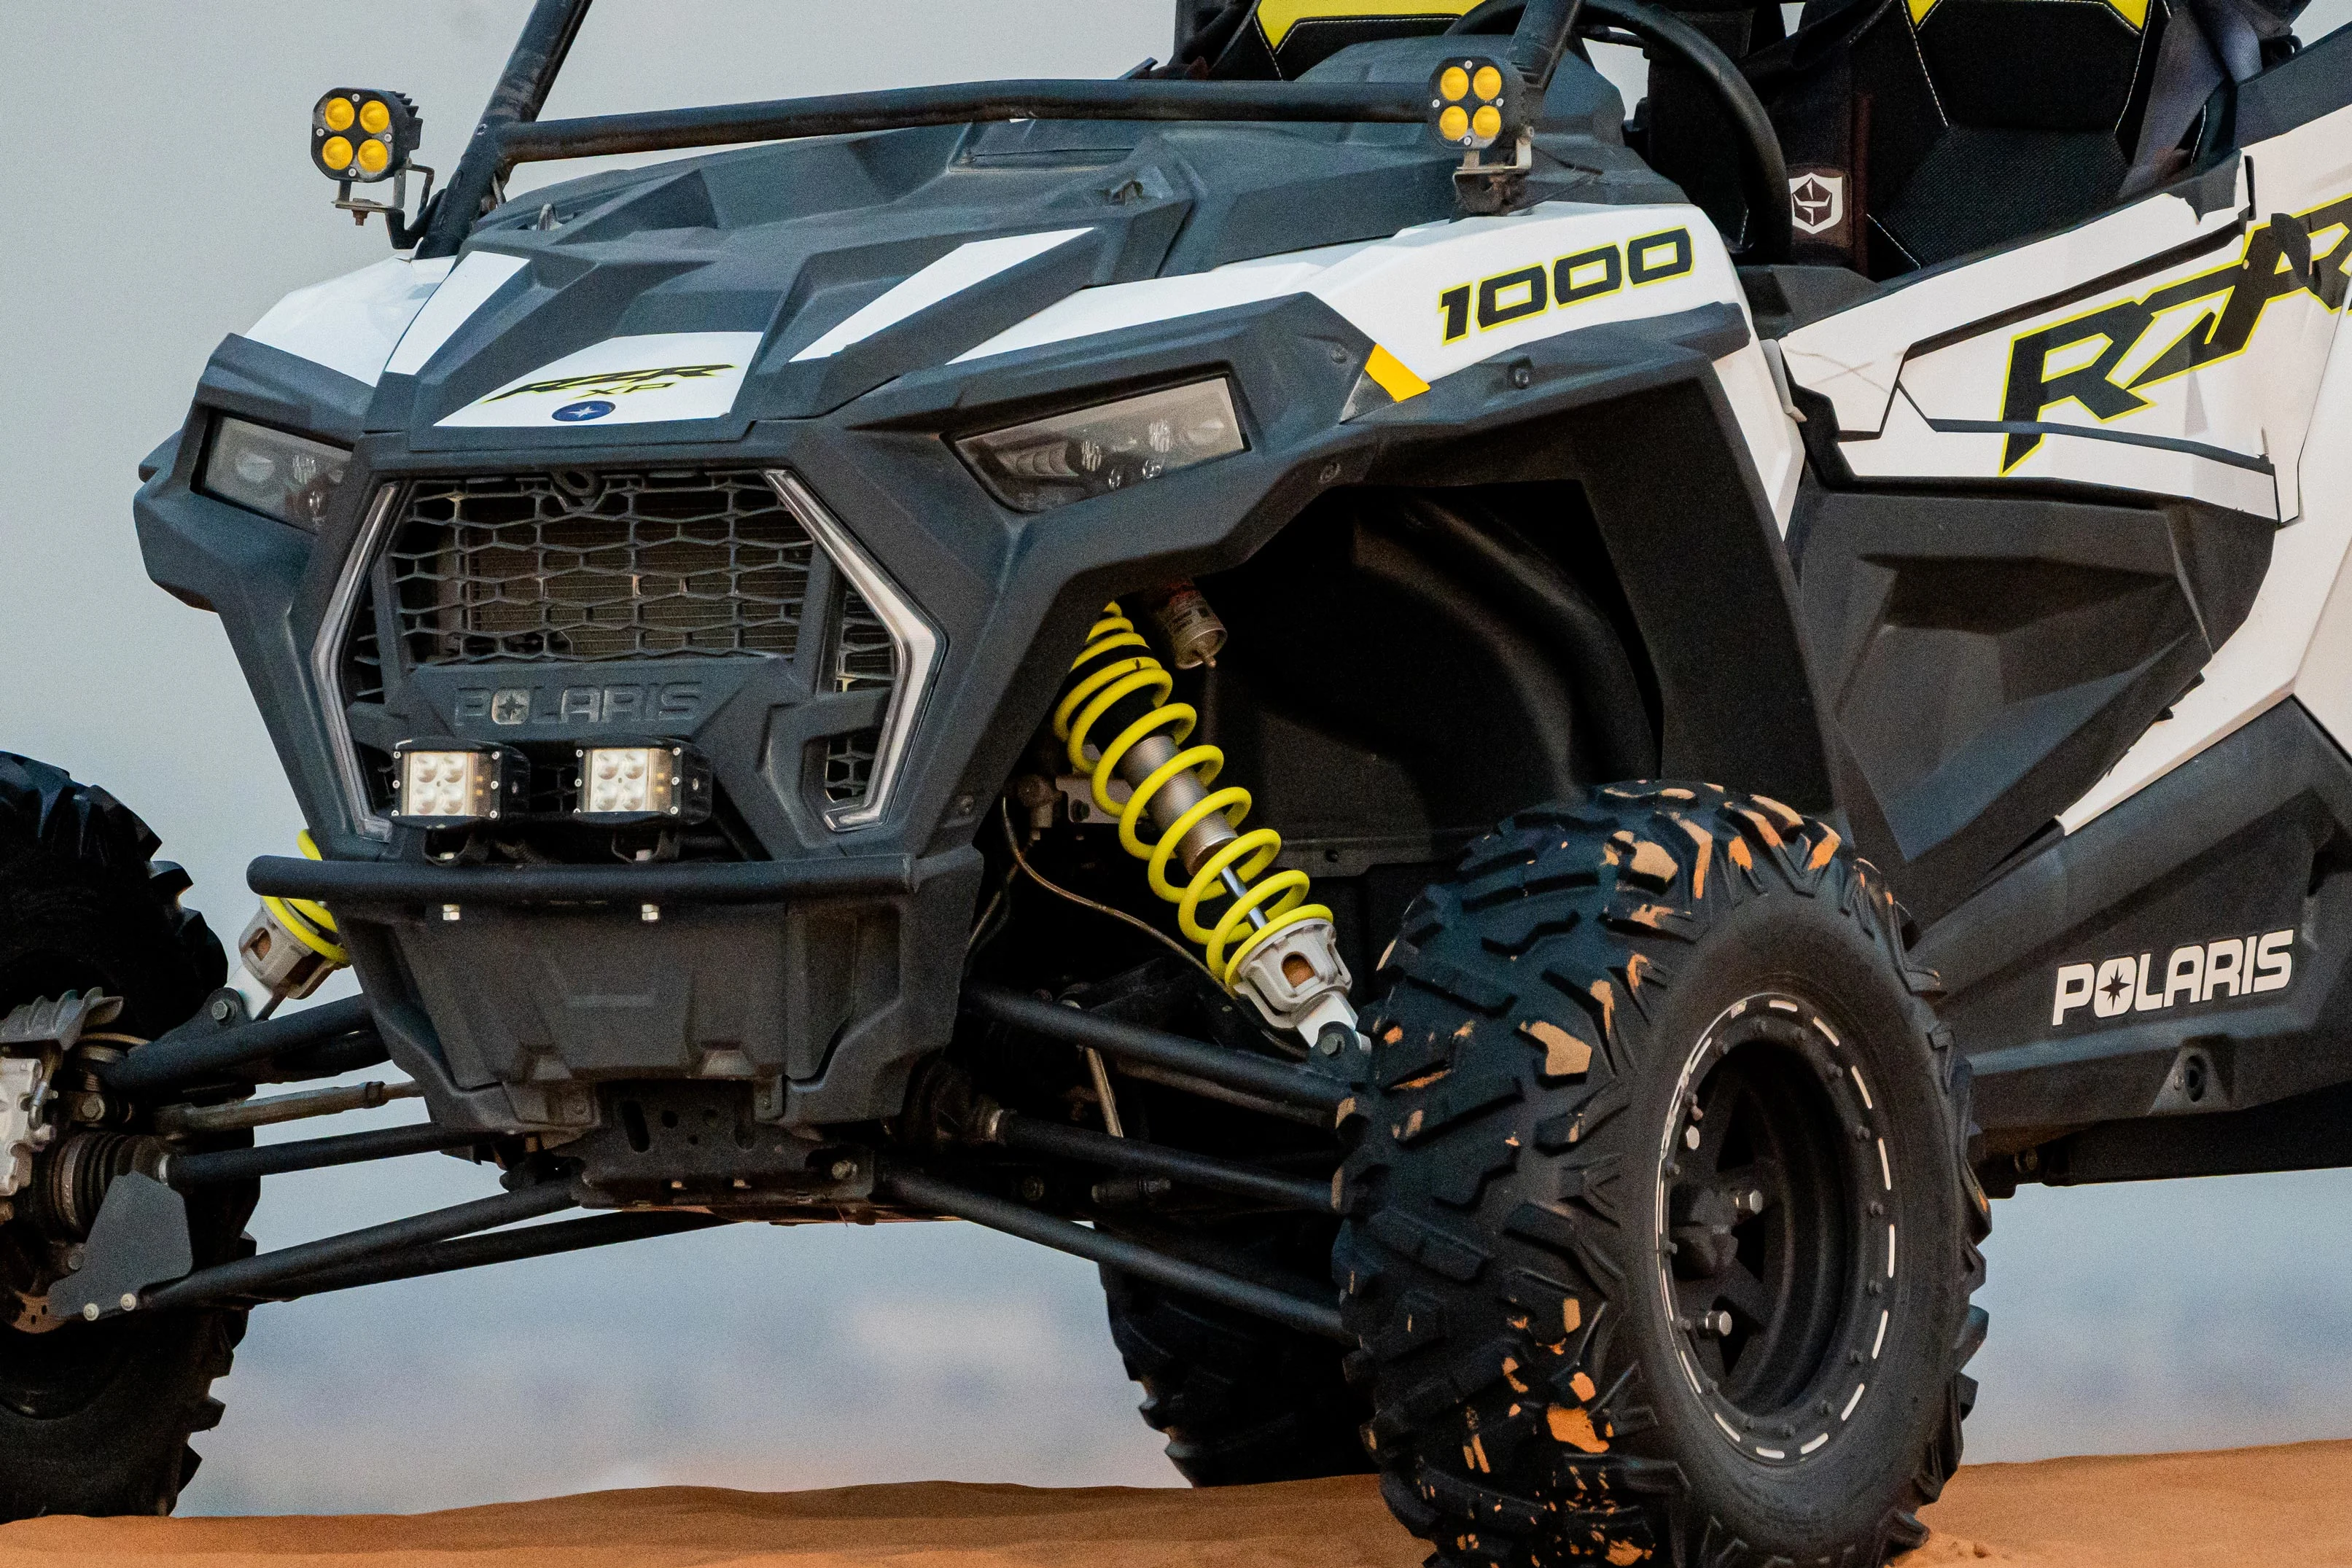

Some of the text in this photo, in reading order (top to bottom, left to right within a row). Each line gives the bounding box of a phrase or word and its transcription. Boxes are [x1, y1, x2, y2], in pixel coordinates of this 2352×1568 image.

[1438, 226, 1694, 347] 1000
[569, 381, 675, 399] XP
[454, 682, 703, 727] POLARIS
[2052, 929, 2294, 1026] POLARIS
